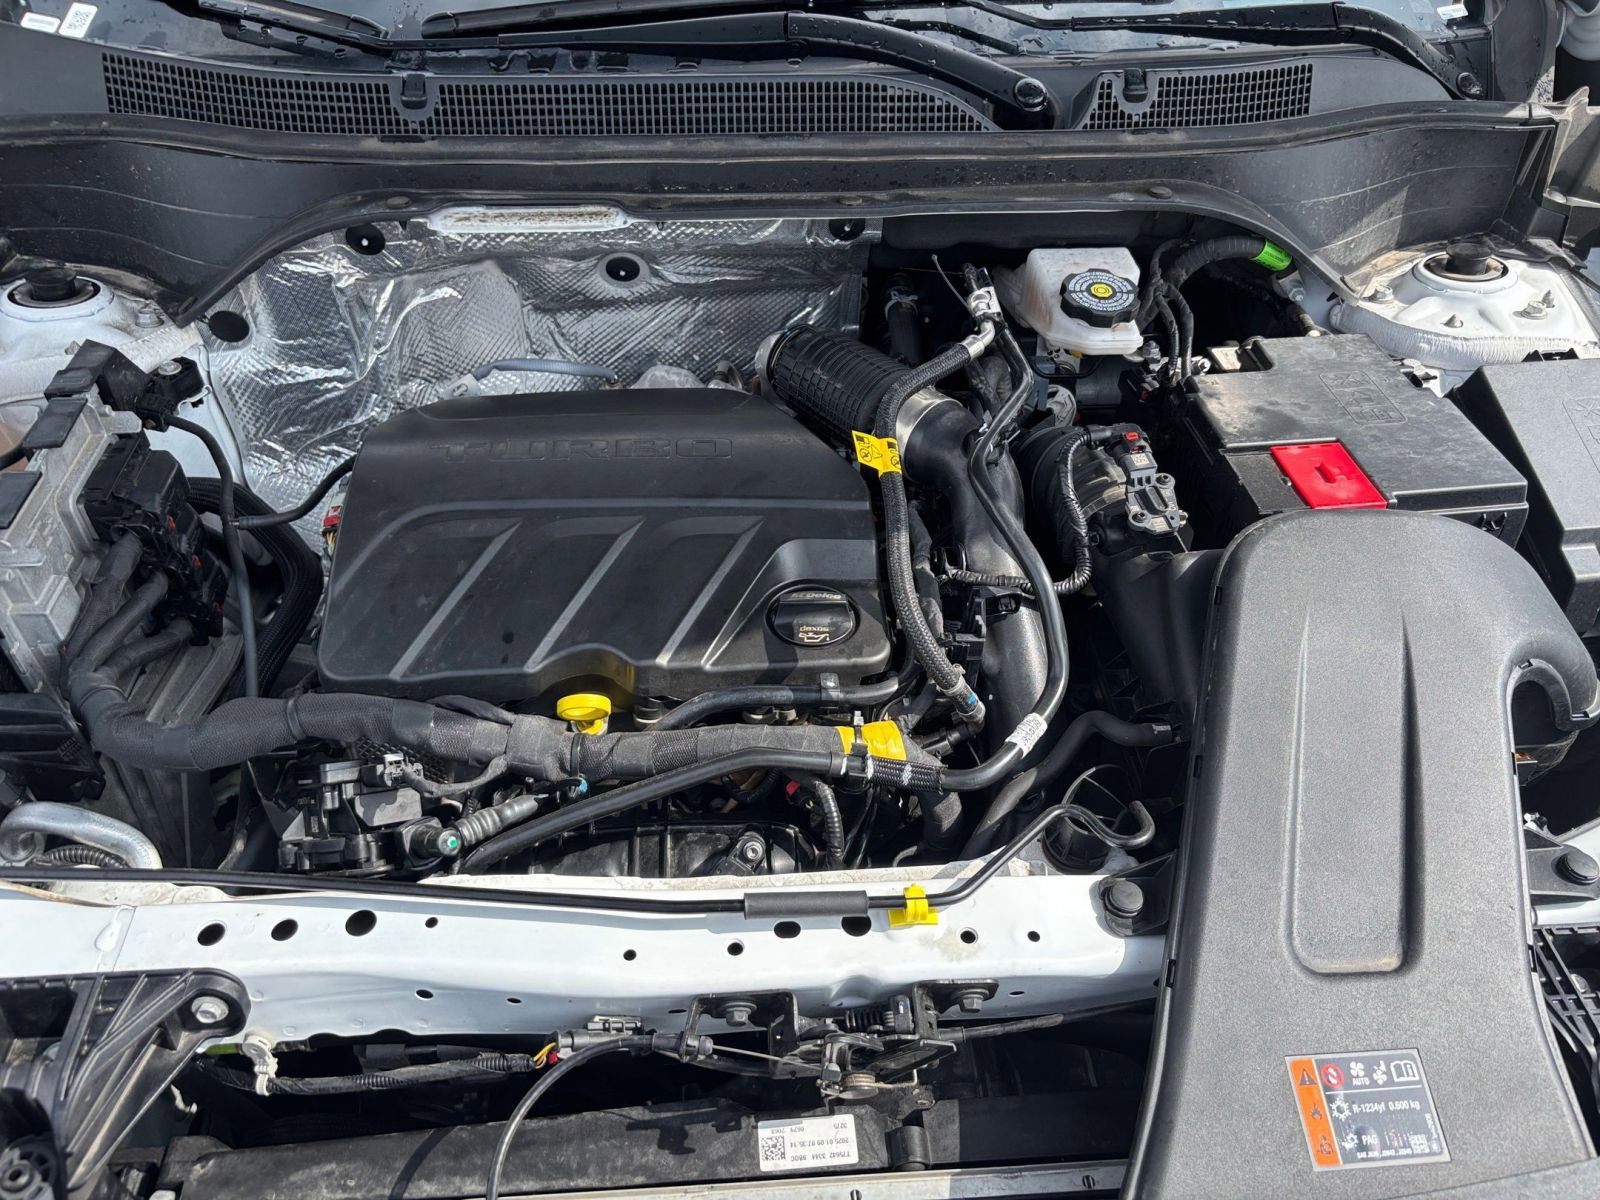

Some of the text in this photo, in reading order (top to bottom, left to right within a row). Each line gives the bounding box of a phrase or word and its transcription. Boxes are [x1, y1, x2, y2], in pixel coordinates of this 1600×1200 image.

[431, 438, 732, 463] TURBO
[1352, 1077, 1370, 1086] AUTO
[1352, 1101, 1385, 1113] R-1234yf
[1409, 1100, 1421, 1111] kg
[1361, 1134, 1378, 1145] PAG
